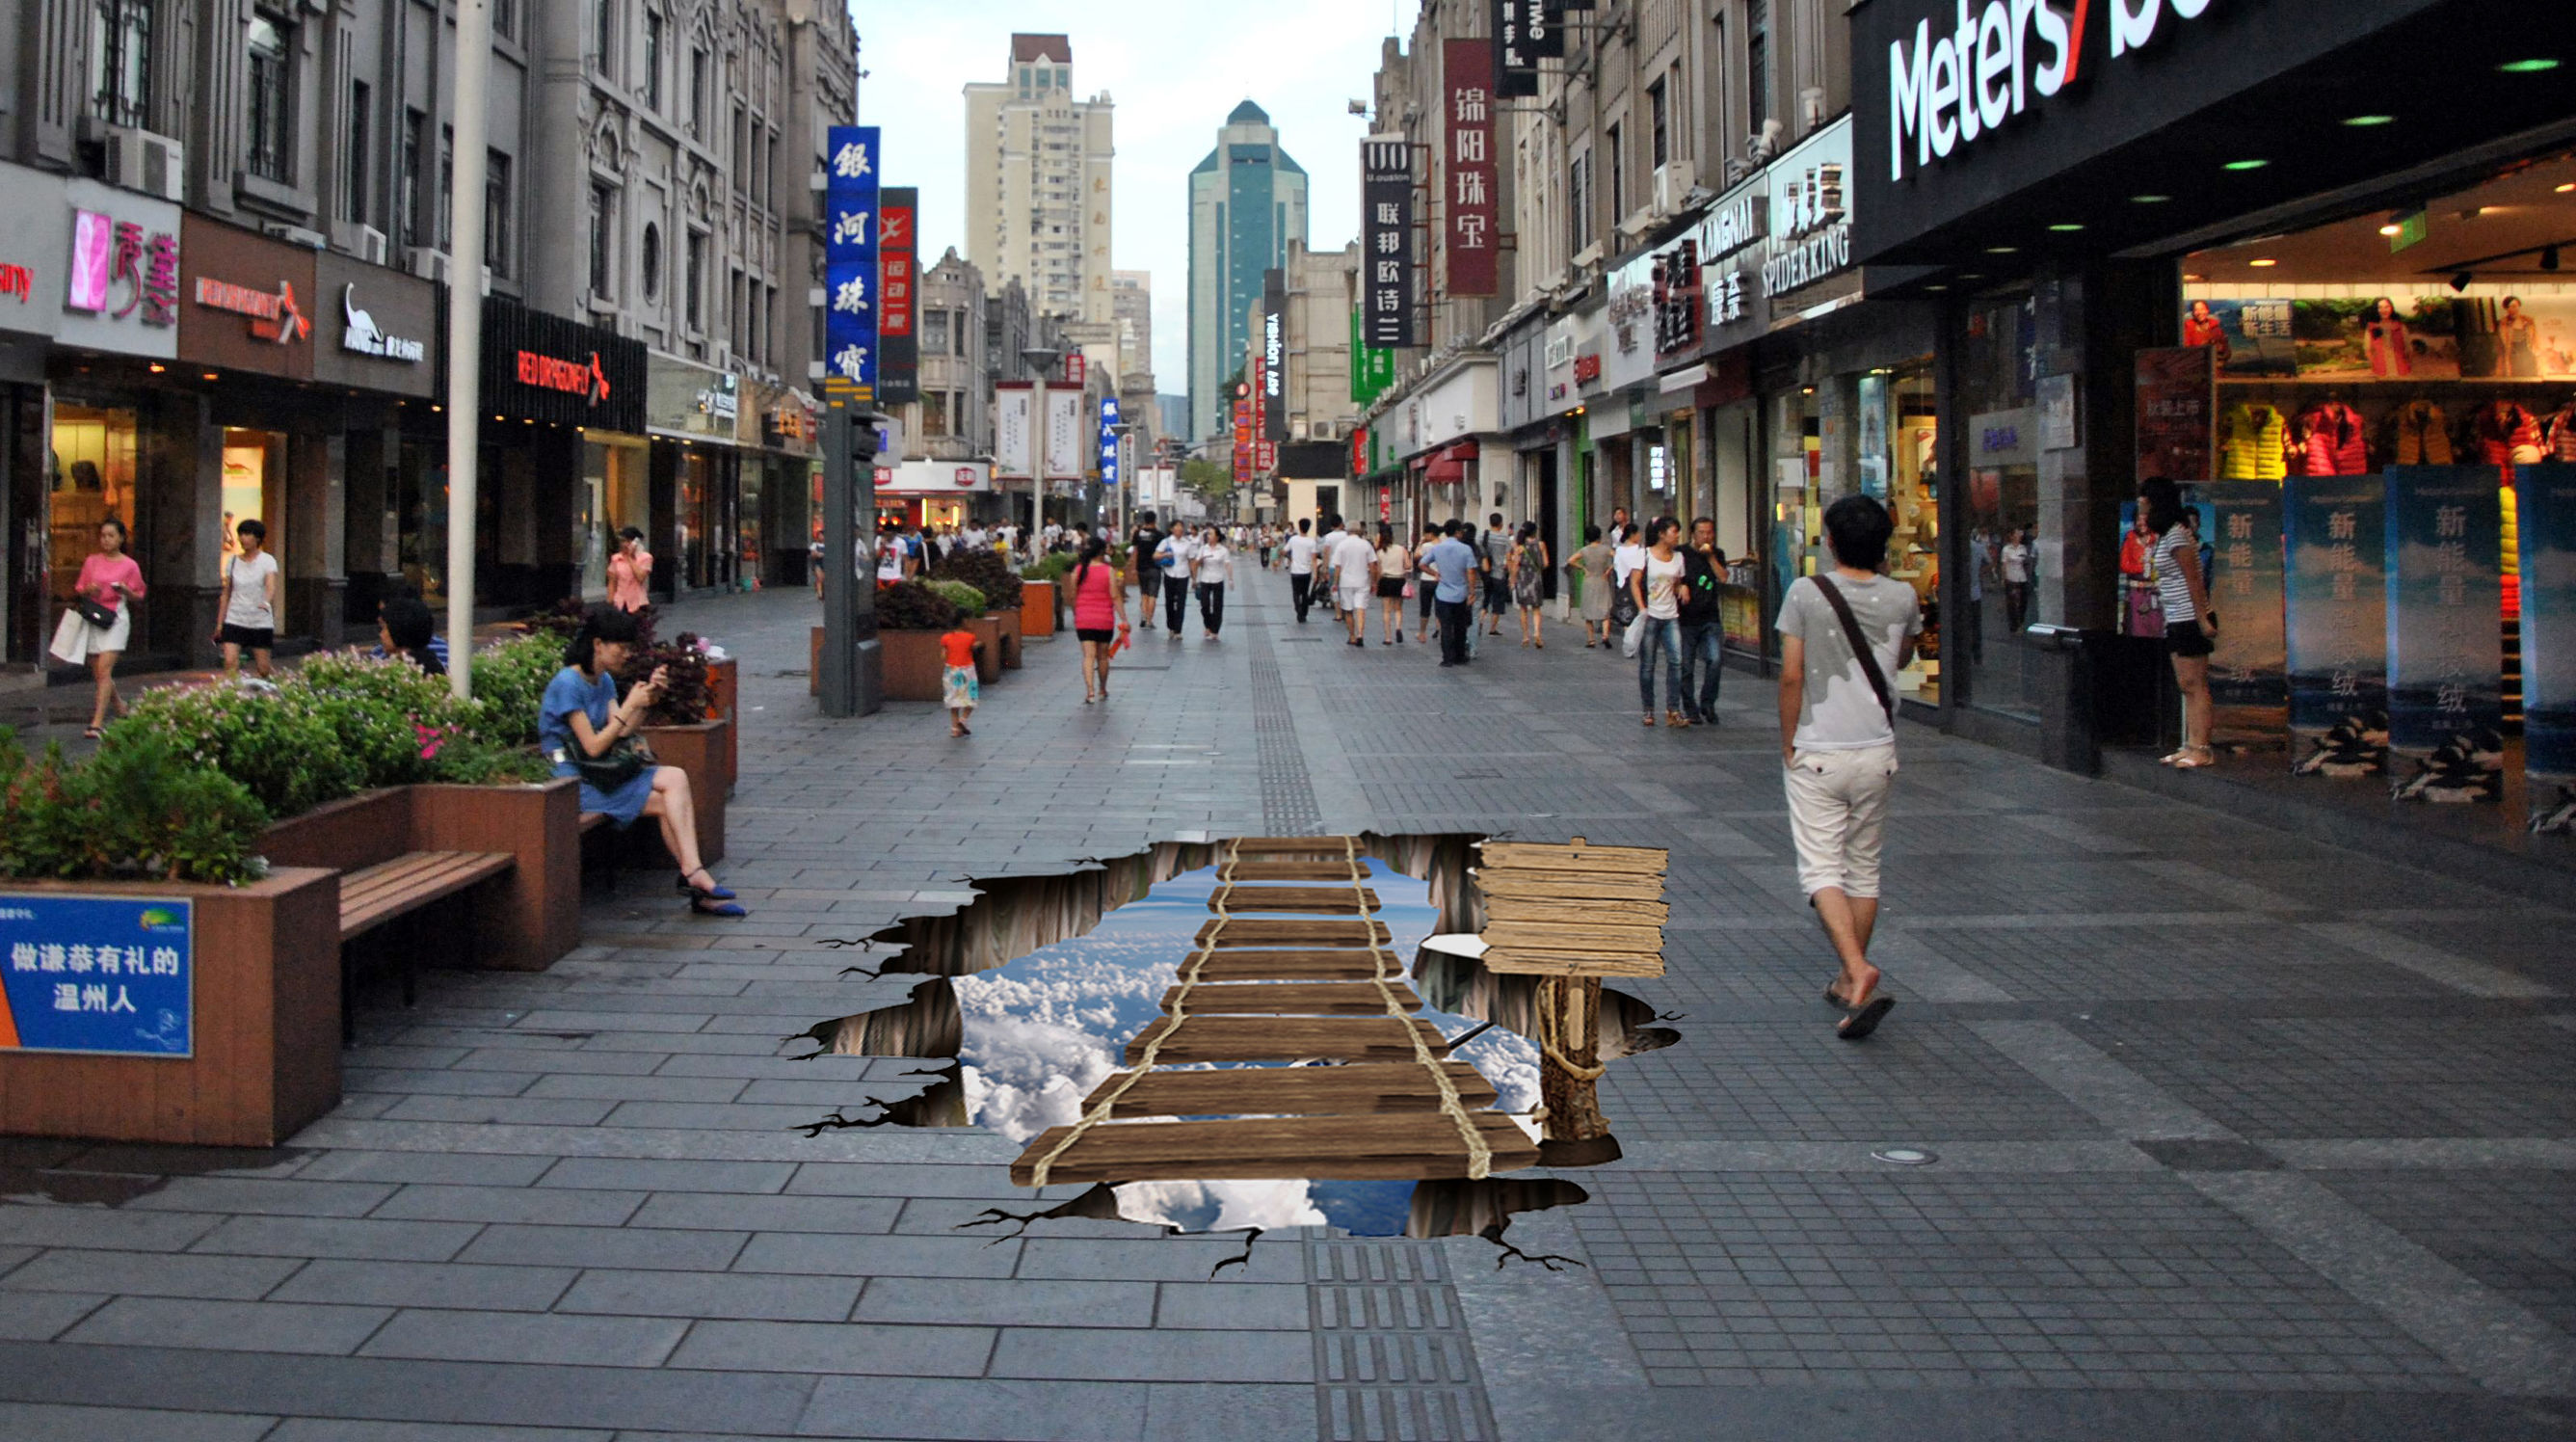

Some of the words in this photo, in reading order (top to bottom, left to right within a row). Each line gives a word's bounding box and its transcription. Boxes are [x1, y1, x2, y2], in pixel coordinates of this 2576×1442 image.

[1456, 88, 1485, 249] 锦阳珠宝
[1696, 195, 1753, 266] KANGNAI
[1762, 246, 1809, 299] SPIDER
[1810, 224, 1849, 280] KING
[1377, 202, 1399, 341] 联邦欧诗兰
[2242, 305, 2290, 321] 新能量
[2242, 321, 2292, 338] 新生活
[2228, 514, 2256, 681] 新能量绒
[12, 943, 179, 975] 做谦恭有礼的
[53, 982, 137, 1013] 温州人
